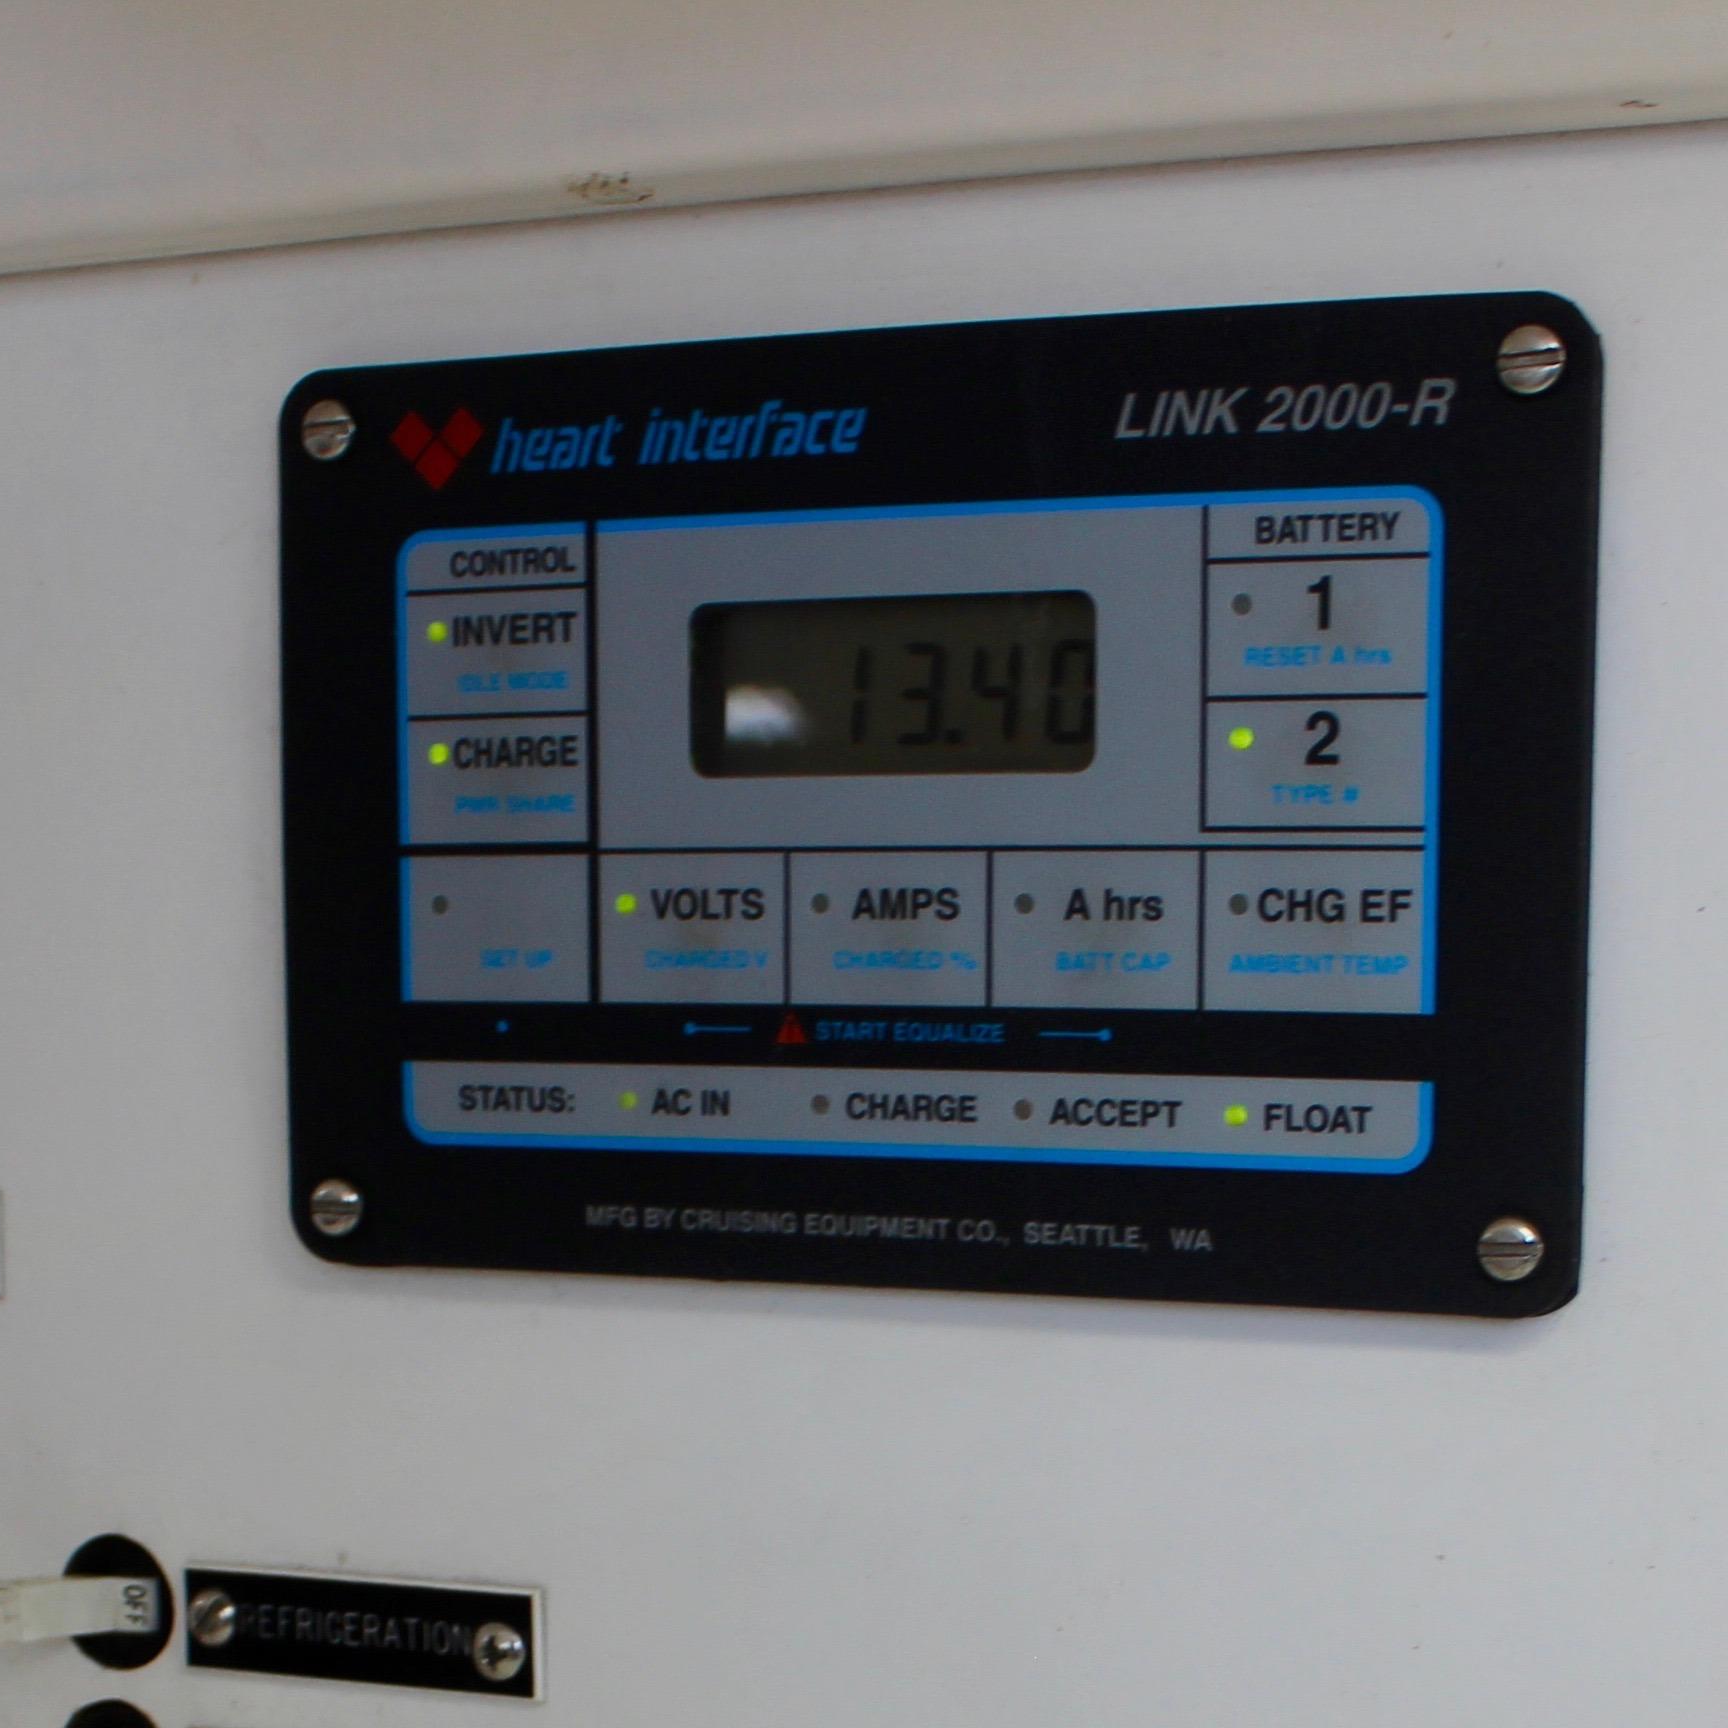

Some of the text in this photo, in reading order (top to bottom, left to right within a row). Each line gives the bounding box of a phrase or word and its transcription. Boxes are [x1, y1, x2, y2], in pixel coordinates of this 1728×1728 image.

[1114, 378, 1458, 440] LINK 2000-R
[489, 400, 869, 474] heart interface
[1254, 511, 1400, 546] BATTERY
[449, 546, 576, 579] CONTROL
[1306, 575, 1334, 631] 1
[452, 611, 578, 648] INVERT
[1244, 644, 1323, 667] RESET
[453, 734, 579, 770] CHARGE
[1304, 710, 1341, 766] 2
[649, 887, 766, 922] VOLTS
[850, 887, 961, 922] AMPS
[1062, 887, 1165, 922] A hrs
[1257, 888, 1413, 924] CHG EF
[1055, 949, 1111, 973] BATT
[1227, 953, 1410, 976] AMBIENT TEMP
[815, 1021, 1007, 1045] START EQUALIZE
[458, 1084, 576, 1114] STATUS:
[650, 1087, 732, 1118] AC IN
[844, 1091, 979, 1126] CHARGE
[1049, 1097, 1183, 1129] ACCEPT
[1263, 1101, 1373, 1136] FLOAT
[585, 1204, 640, 1229] MFG
[644, 1206, 674, 1231] BY
[680, 1207, 798, 1235] CRUISING
[803, 1211, 951, 1241] EQUIPMENT
[1170, 1227, 1214, 1253] WA
[234, 1601, 473, 1657] REFRIGERATION
